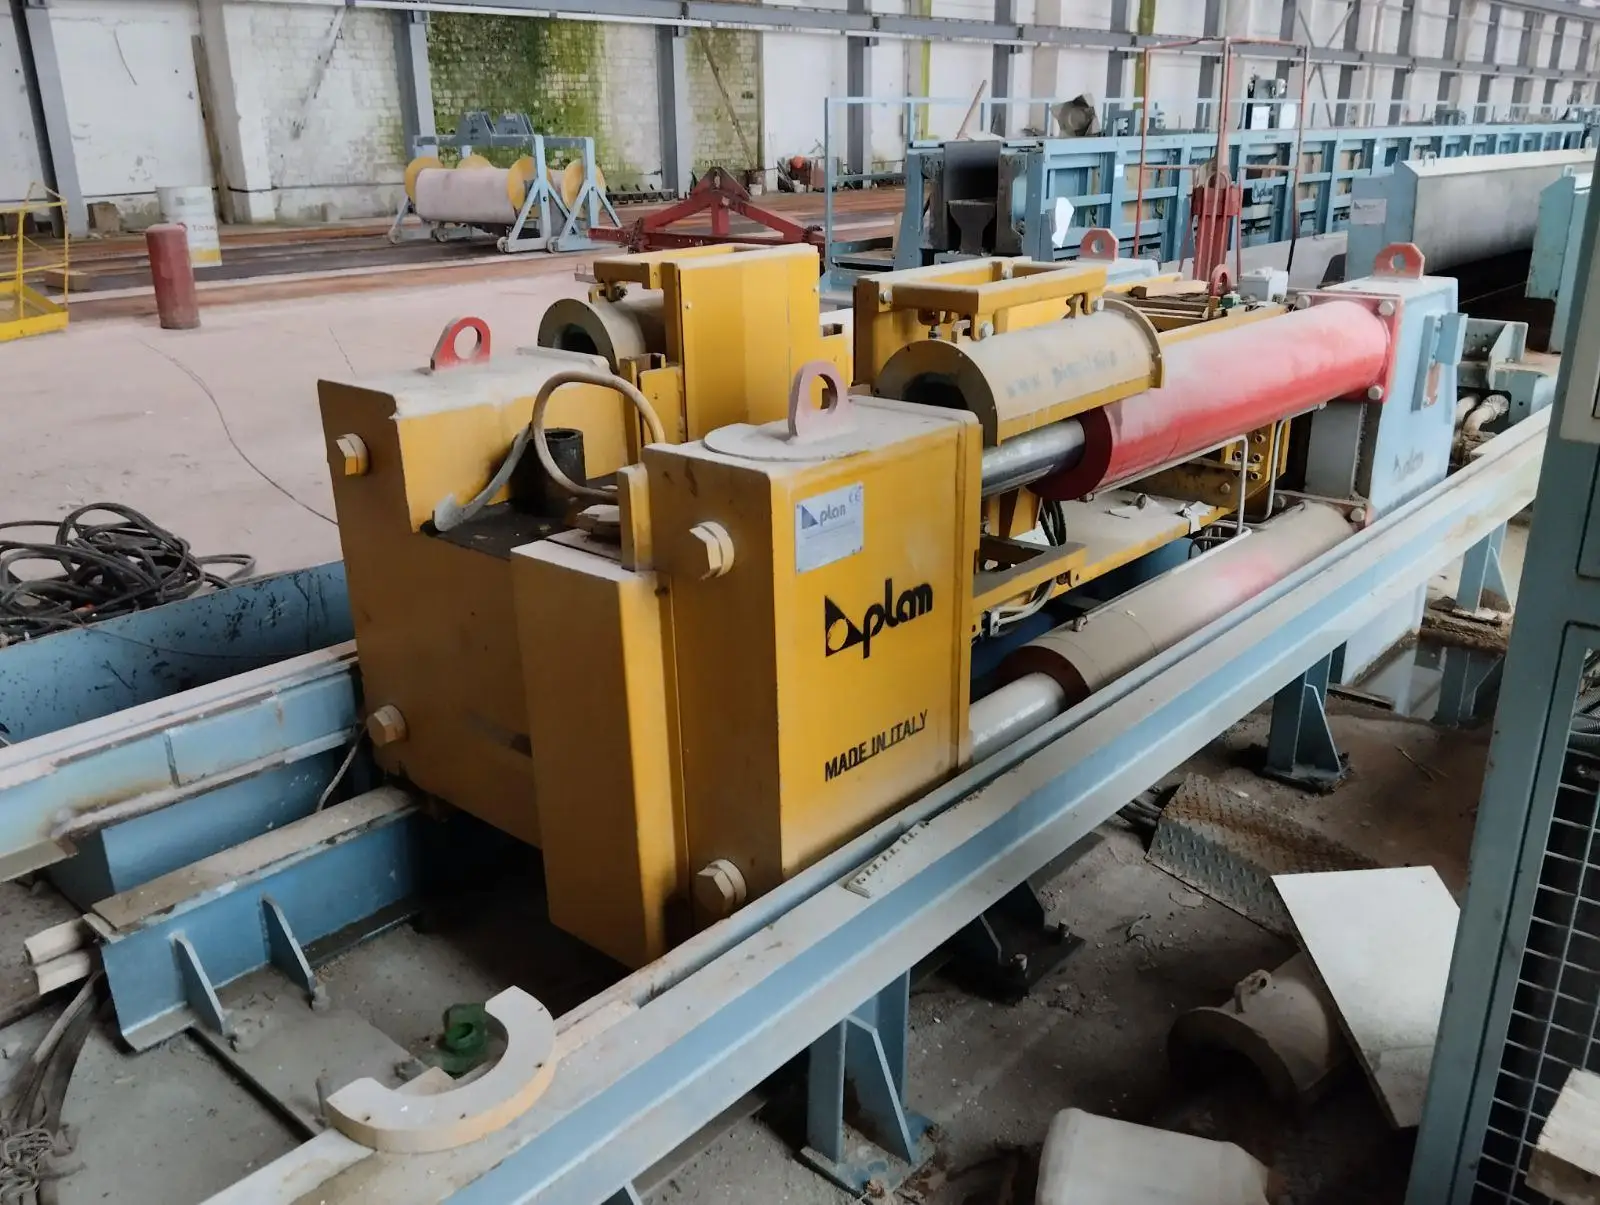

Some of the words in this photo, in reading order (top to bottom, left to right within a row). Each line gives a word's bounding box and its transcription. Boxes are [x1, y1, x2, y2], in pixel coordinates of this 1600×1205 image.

[820, 504, 846, 526] plan
[863, 577, 933, 659] plan
[825, 739, 867, 782] MADE
[871, 731, 886, 756] IN
[889, 708, 928, 745] ITALY
